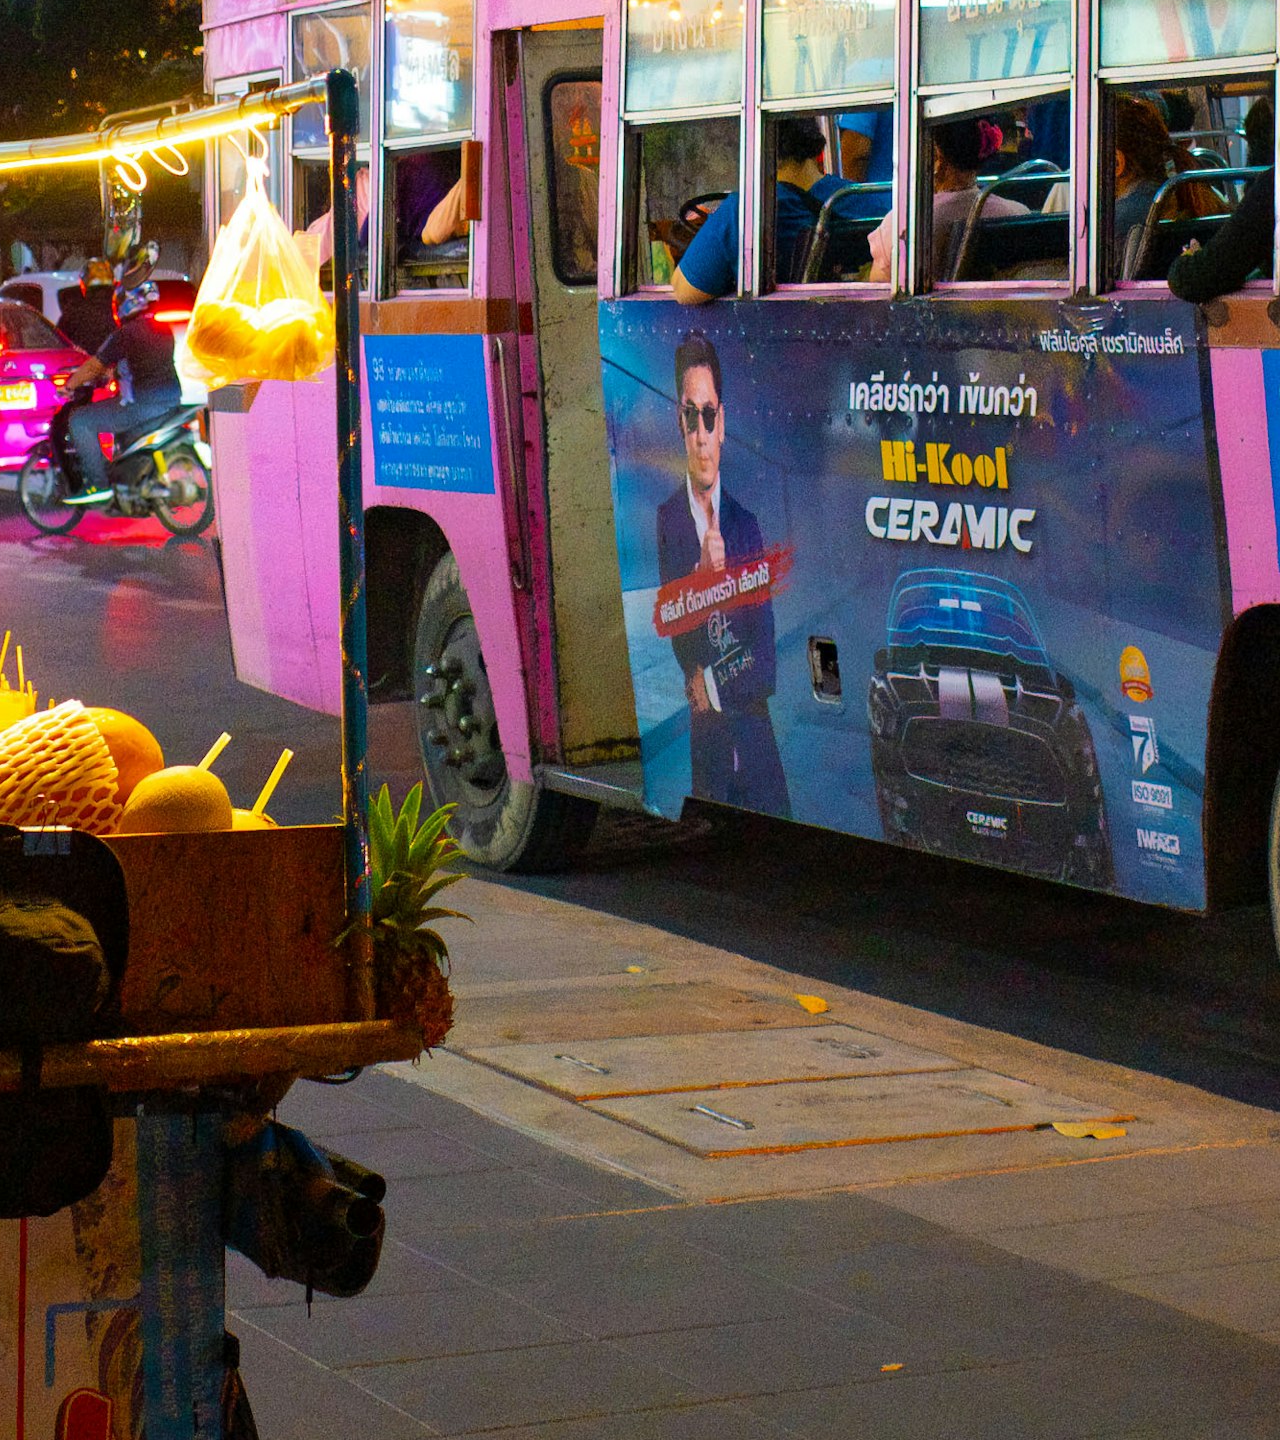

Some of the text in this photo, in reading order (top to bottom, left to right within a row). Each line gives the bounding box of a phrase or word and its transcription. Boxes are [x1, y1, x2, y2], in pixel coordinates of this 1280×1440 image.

[849, 370, 1038, 417] เคลียร์กว่า เข้มกว่า
[880, 440, 1009, 490] Hi-Kool
[865, 496, 1036, 553] CERAMIC
